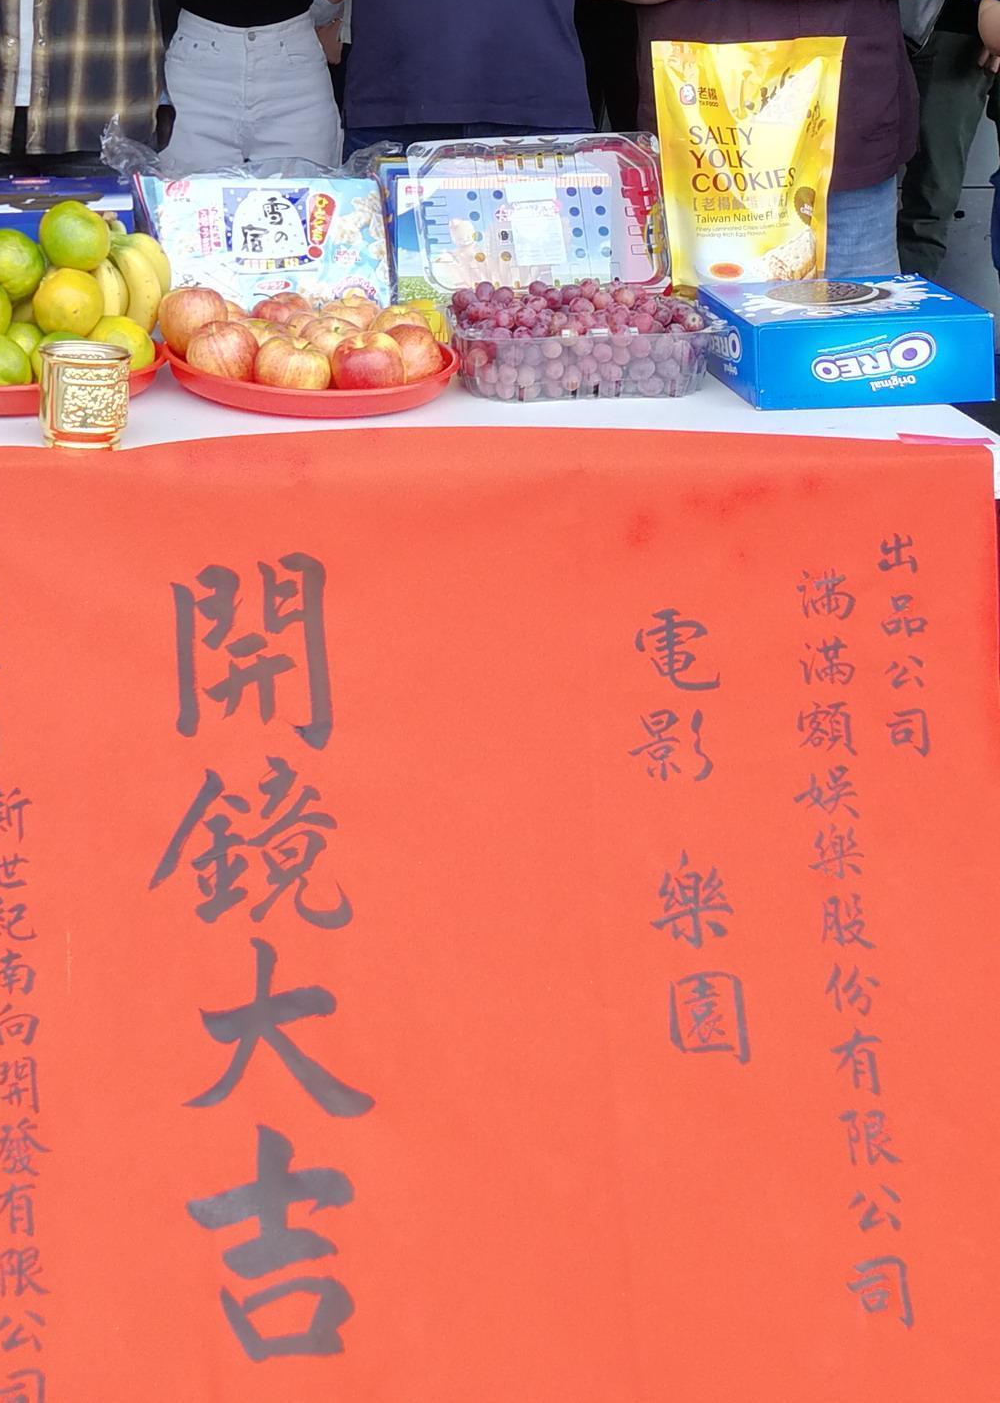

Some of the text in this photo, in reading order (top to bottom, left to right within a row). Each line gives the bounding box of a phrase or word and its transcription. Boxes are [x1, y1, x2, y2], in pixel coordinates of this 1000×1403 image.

[689, 125, 753, 146] SALTY
[689, 148, 753, 169] YOLK
[691, 167, 797, 193] COOKIES
[695, 214, 731, 224] Taiwan
[733, 212, 764, 222] Native
[815, 337, 931, 380] OREO
[870, 373, 916, 392] Original
[878, 534, 930, 757] 出品公司
[628, 608, 751, 1066] 電影 樂園
[149, 552, 375, 1362] 開鏡大吉
